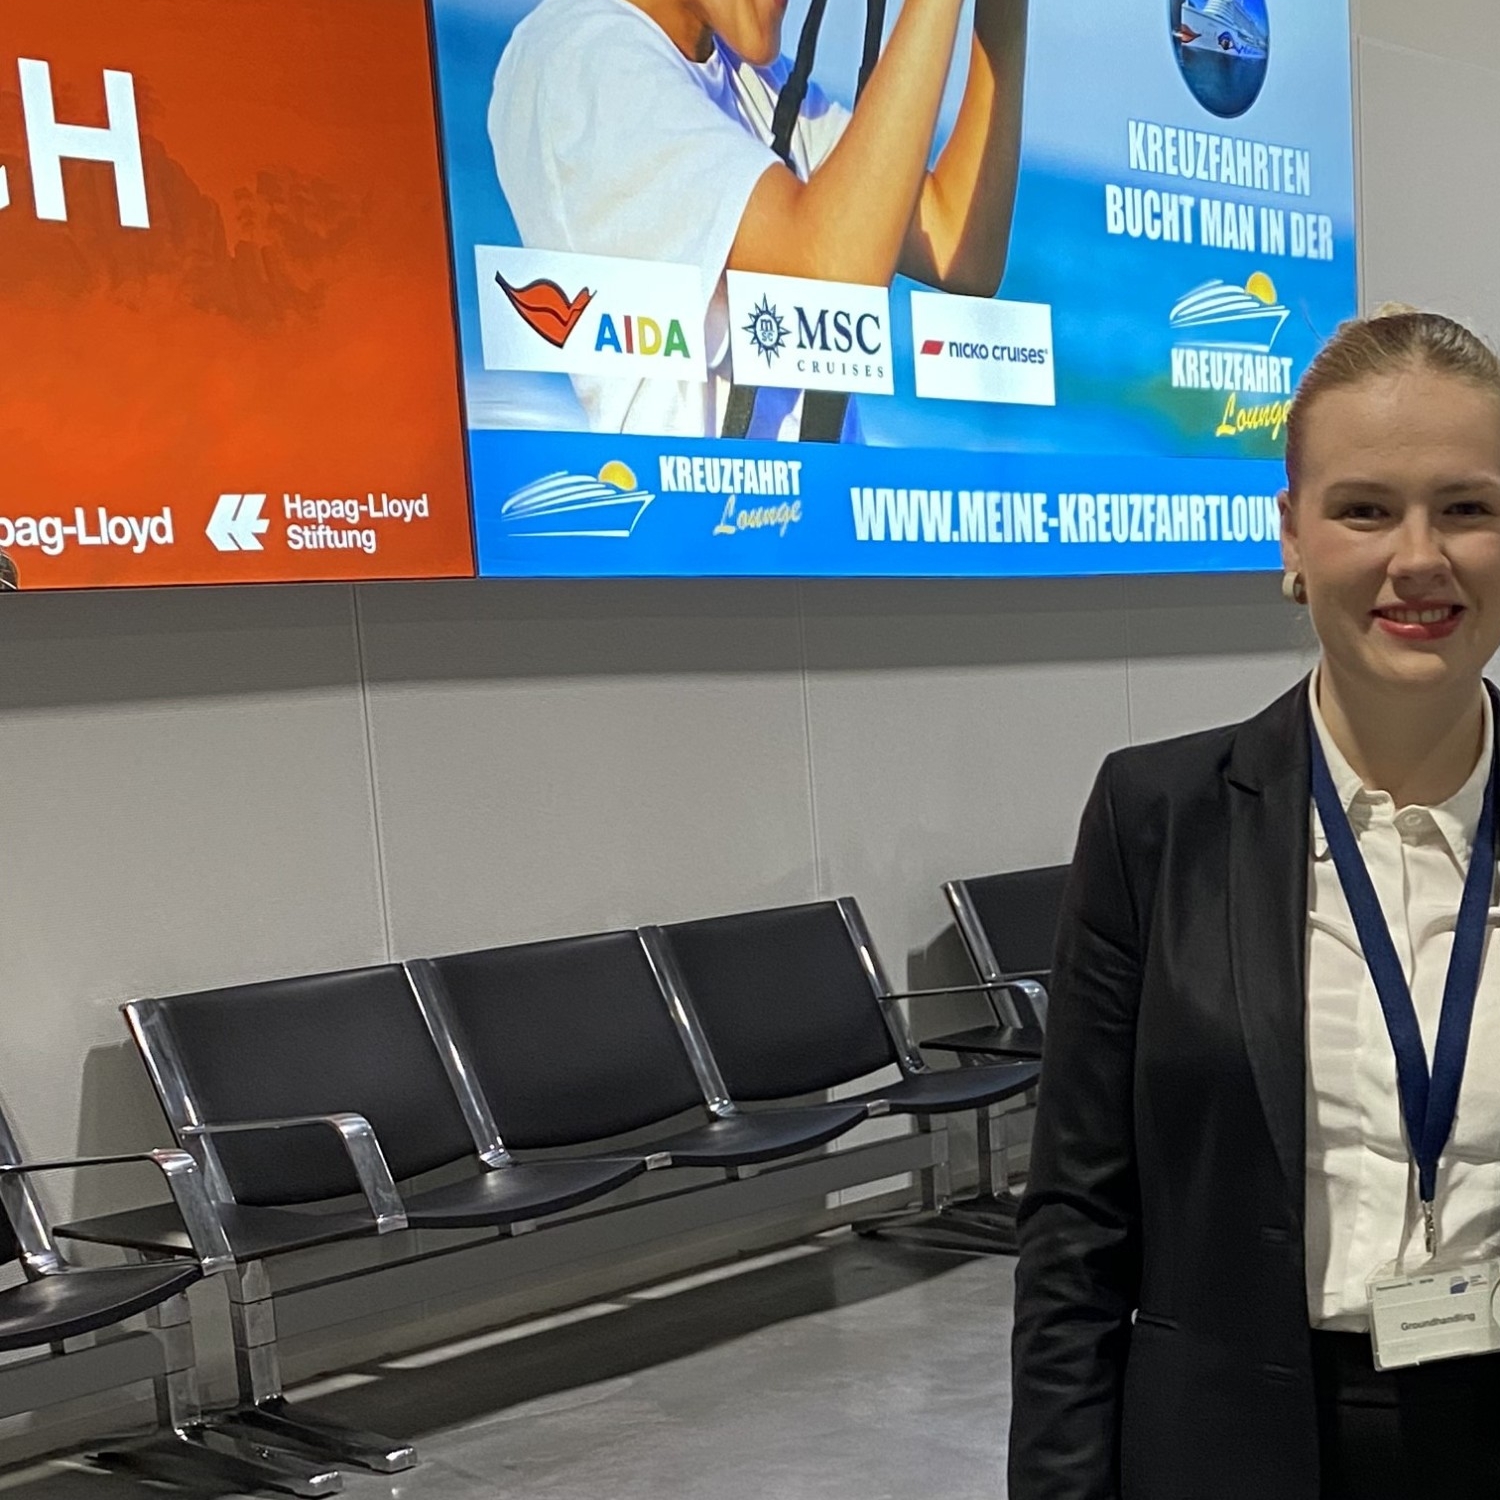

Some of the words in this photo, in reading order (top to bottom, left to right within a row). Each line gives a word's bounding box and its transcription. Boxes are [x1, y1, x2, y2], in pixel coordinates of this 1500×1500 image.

[0, 57, 150, 229] H
[1128, 120, 1311, 196] KREUZFAHRTEN
[1105, 184, 1195, 244] BUCHT
[1201, 198, 1256, 253] MAN
[1260, 207, 1286, 256] IN
[1290, 211, 1334, 261] DER
[594, 313, 691, 358] AIDA
[794, 306, 881, 355] MSC
[797, 359, 884, 378] CRUISES
[1171, 348, 1293, 394] KREUZFAHRT
[659, 455, 802, 496] KREUZFAHRT
[283, 493, 430, 524] Hapag-Lloyd
[713, 494, 802, 537] Lounge
[286, 524, 377, 554] Stiftung
